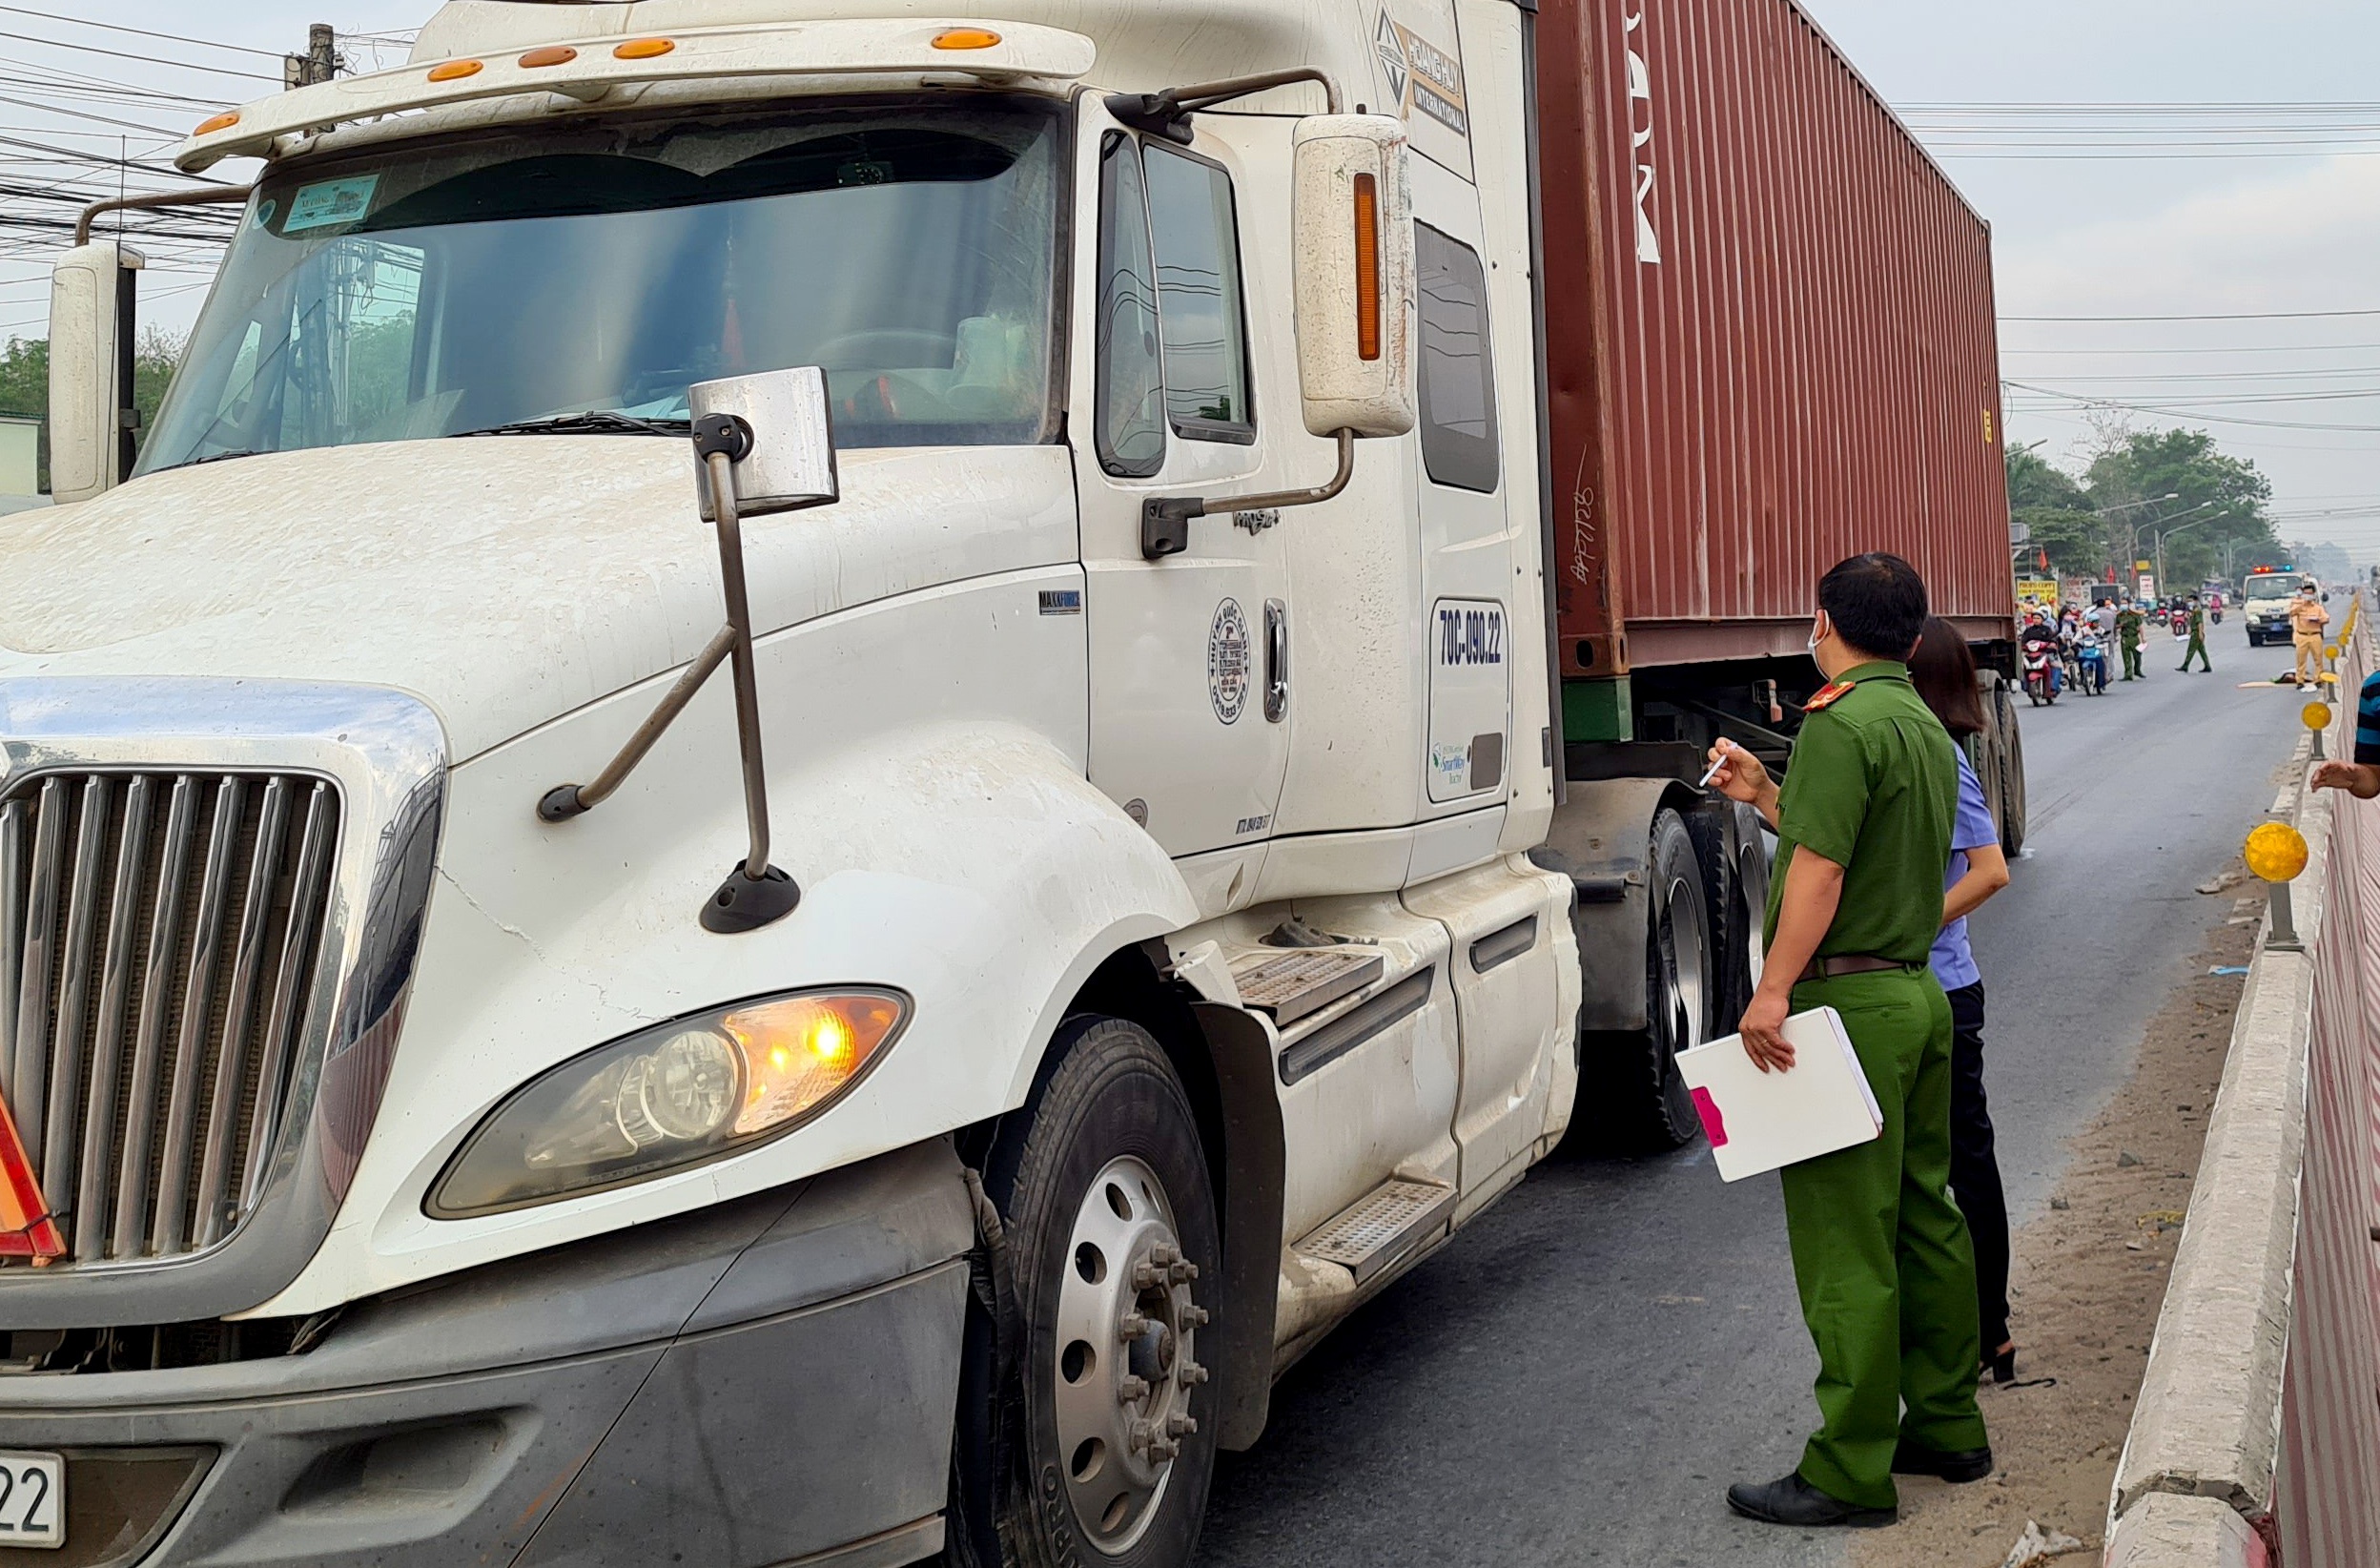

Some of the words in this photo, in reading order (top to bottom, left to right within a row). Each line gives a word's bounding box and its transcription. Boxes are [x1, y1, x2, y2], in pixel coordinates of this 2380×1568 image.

[1414, 83, 1465, 133] INTERNATIONAL
[1440, 609, 1501, 666] 70C-090.22
[0, 1465, 50, 1532] 22
